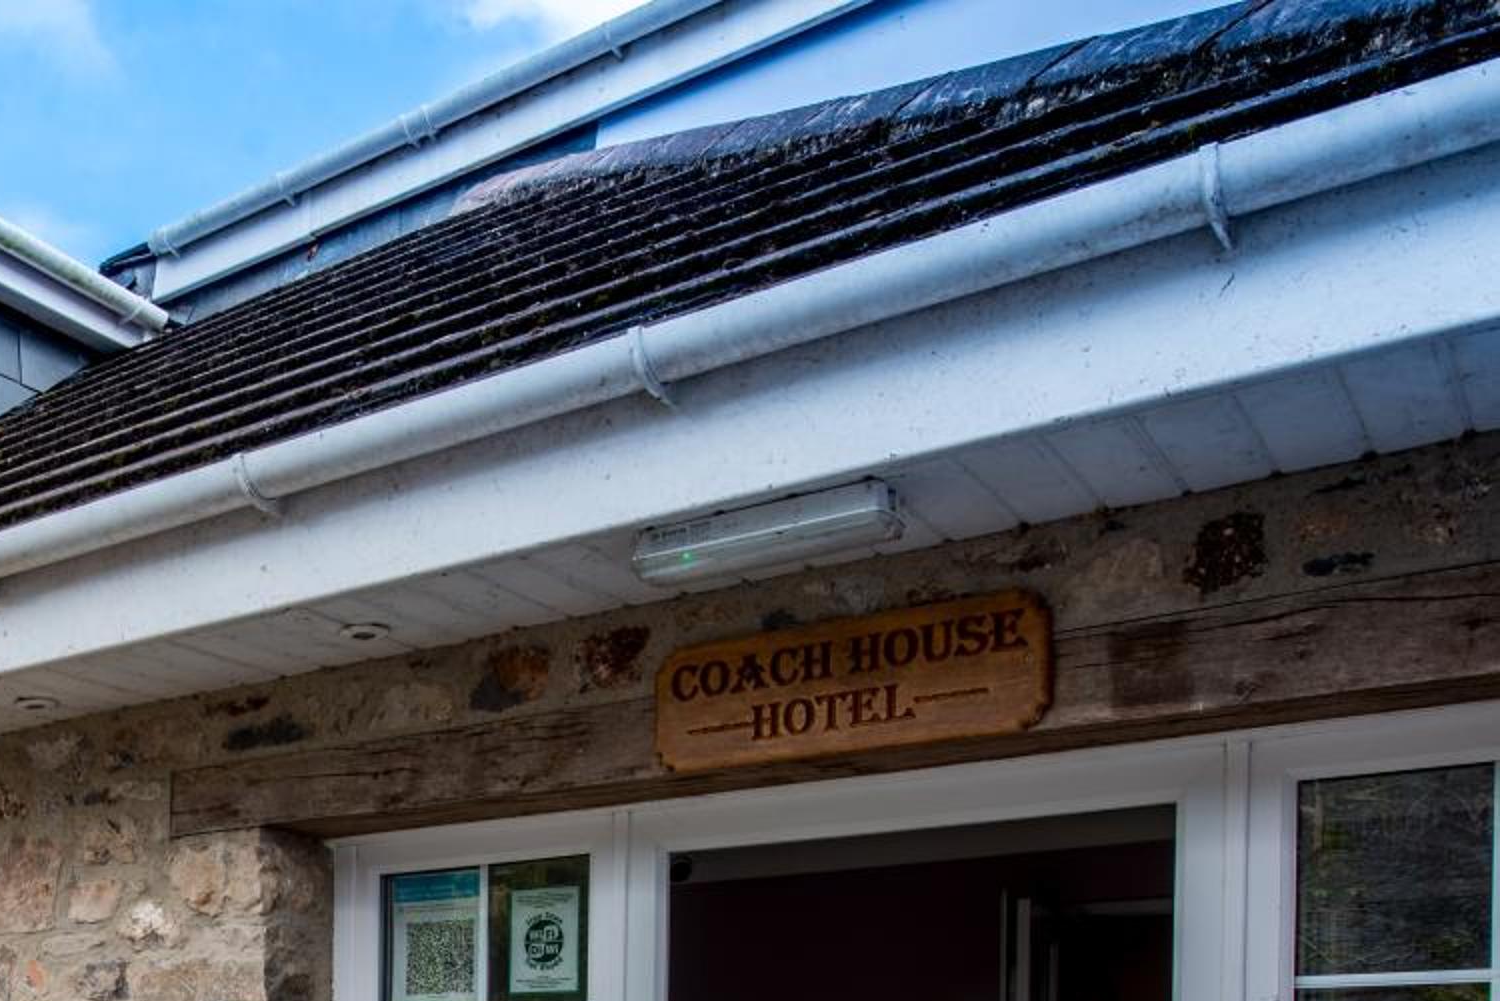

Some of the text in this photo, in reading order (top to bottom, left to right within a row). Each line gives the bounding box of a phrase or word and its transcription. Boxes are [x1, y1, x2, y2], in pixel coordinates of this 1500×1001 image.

[671, 607, 1029, 701] COACH HOUSE
[751, 684, 916, 740] HOTEL
